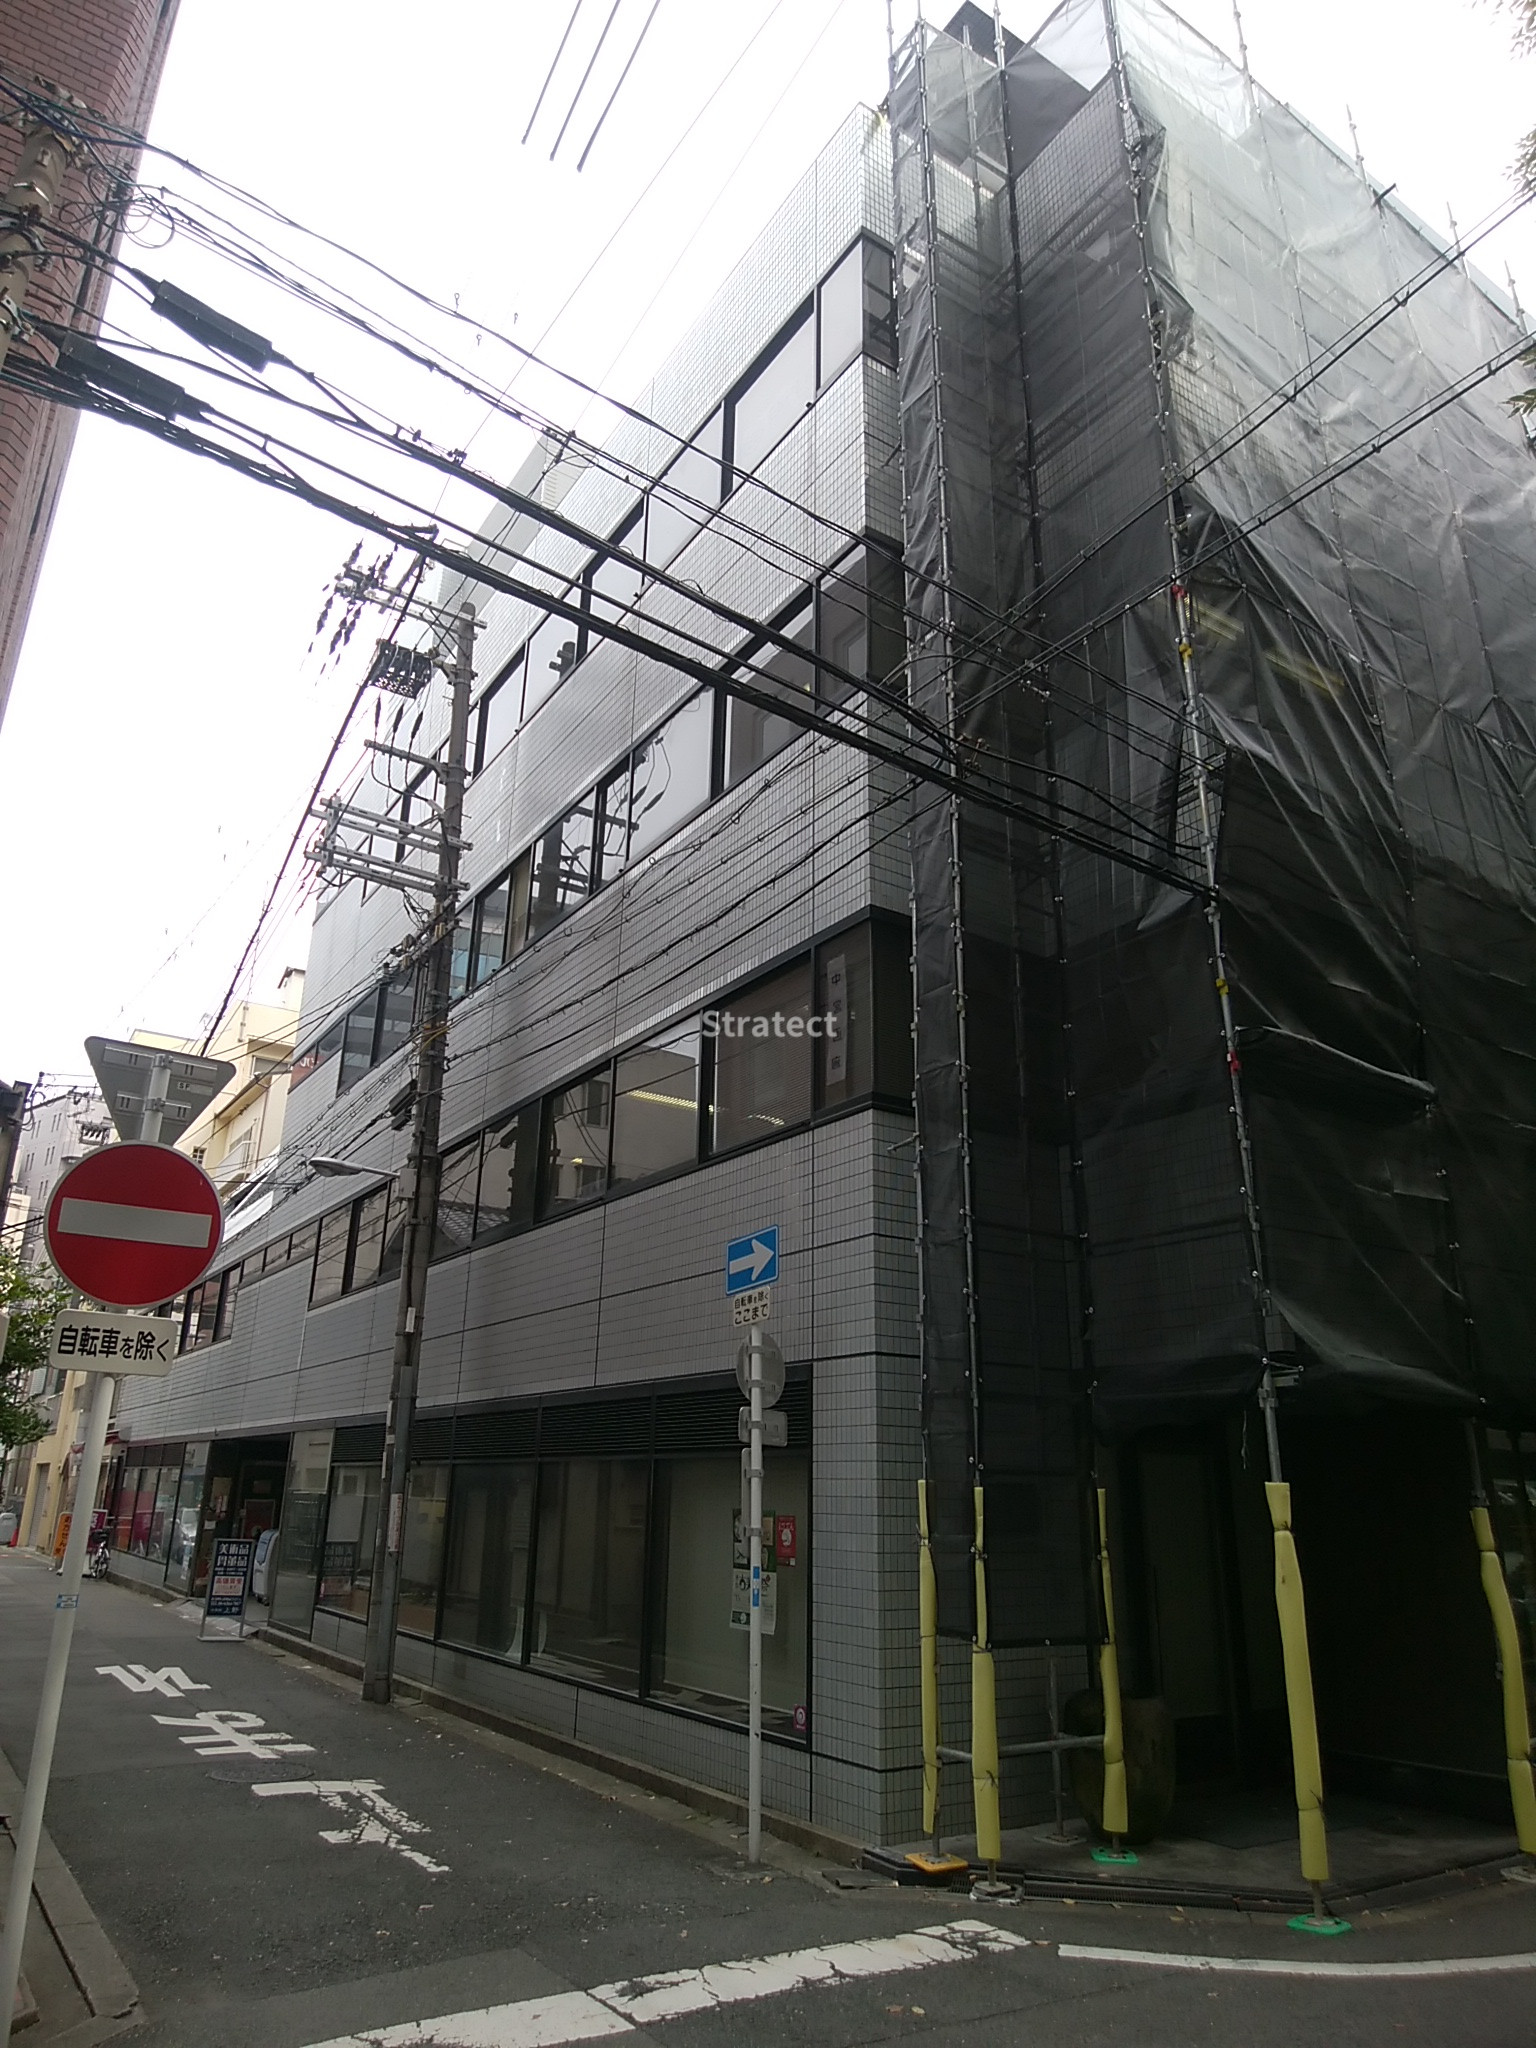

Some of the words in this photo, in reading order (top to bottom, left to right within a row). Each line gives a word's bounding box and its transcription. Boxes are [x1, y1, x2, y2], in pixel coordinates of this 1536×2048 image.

[735, 1291, 769, 1310] 自転車を除く
[734, 1304, 768, 1325] ここまで
[57, 1323, 170, 1362] 自転車を除く
[218, 1543, 249, 1555] 美術品
